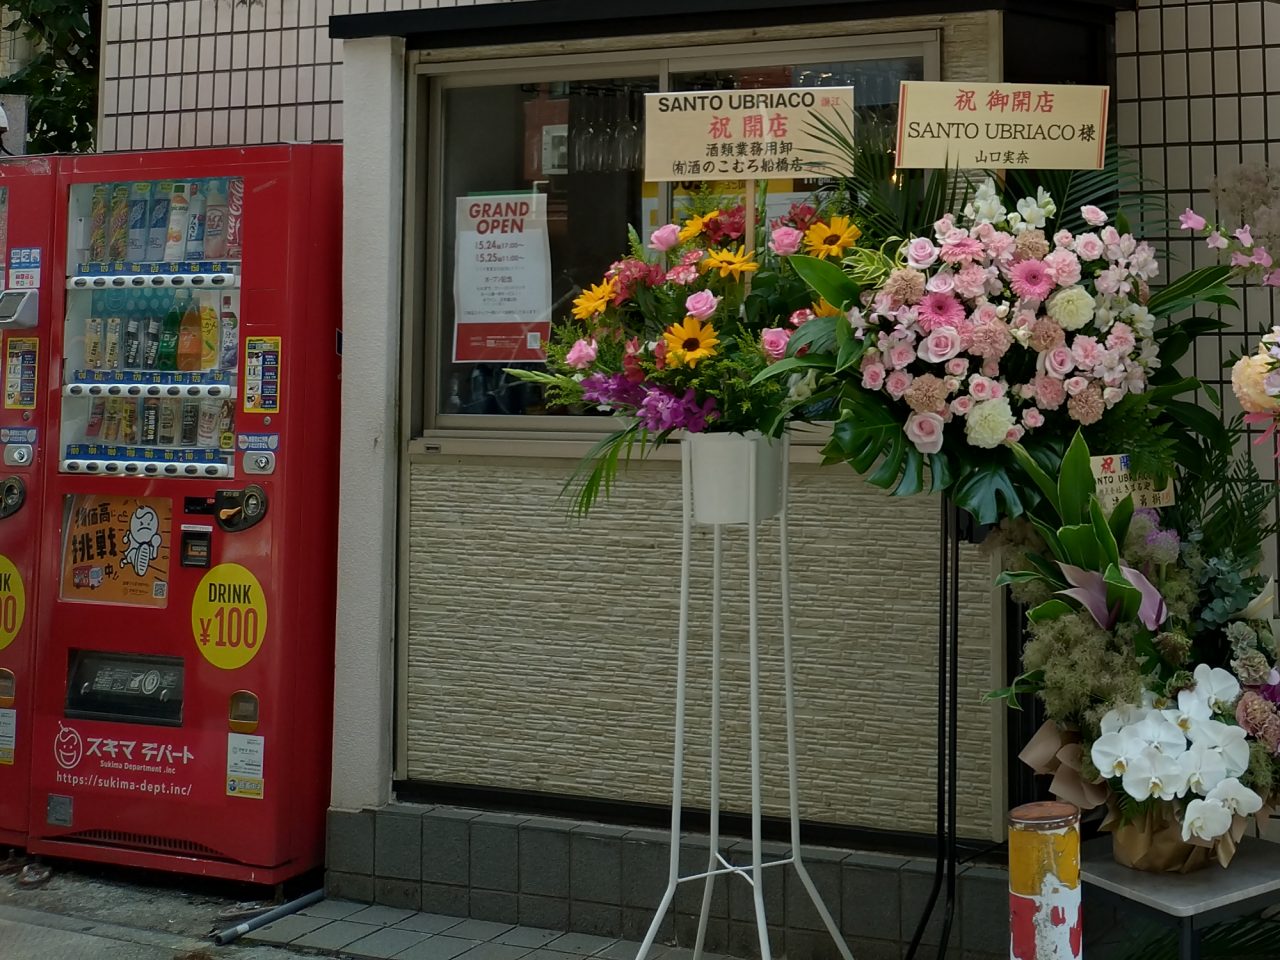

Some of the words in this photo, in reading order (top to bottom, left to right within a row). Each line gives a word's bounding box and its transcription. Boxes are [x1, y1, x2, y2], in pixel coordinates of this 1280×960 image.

[658, 95, 724, 113] SANTO
[728, 92, 815, 111] UBRIACO
[955, 89, 978, 113] 祝
[988, 90, 1055, 114] 御開店
[709, 116, 732, 140] 祝
[743, 113, 789, 138] 開店
[907, 122, 979, 141] SANTO
[705, 141, 793, 158] 酒類業務用卸
[974, 149, 1030, 165] 山口実奈
[469, 201, 530, 219] GRAND
[476, 218, 524, 235] OPEN
[208, 583, 251, 604] DRINK
[199, 606, 259, 649] ¥100
[86, 737, 137, 761] スキマ
[141, 741, 195, 765] デパート
[100, 760, 123, 770] Sukima
[123, 761, 162, 773] Department
[56, 770, 193, 797] https://sukima-dept.inc/
